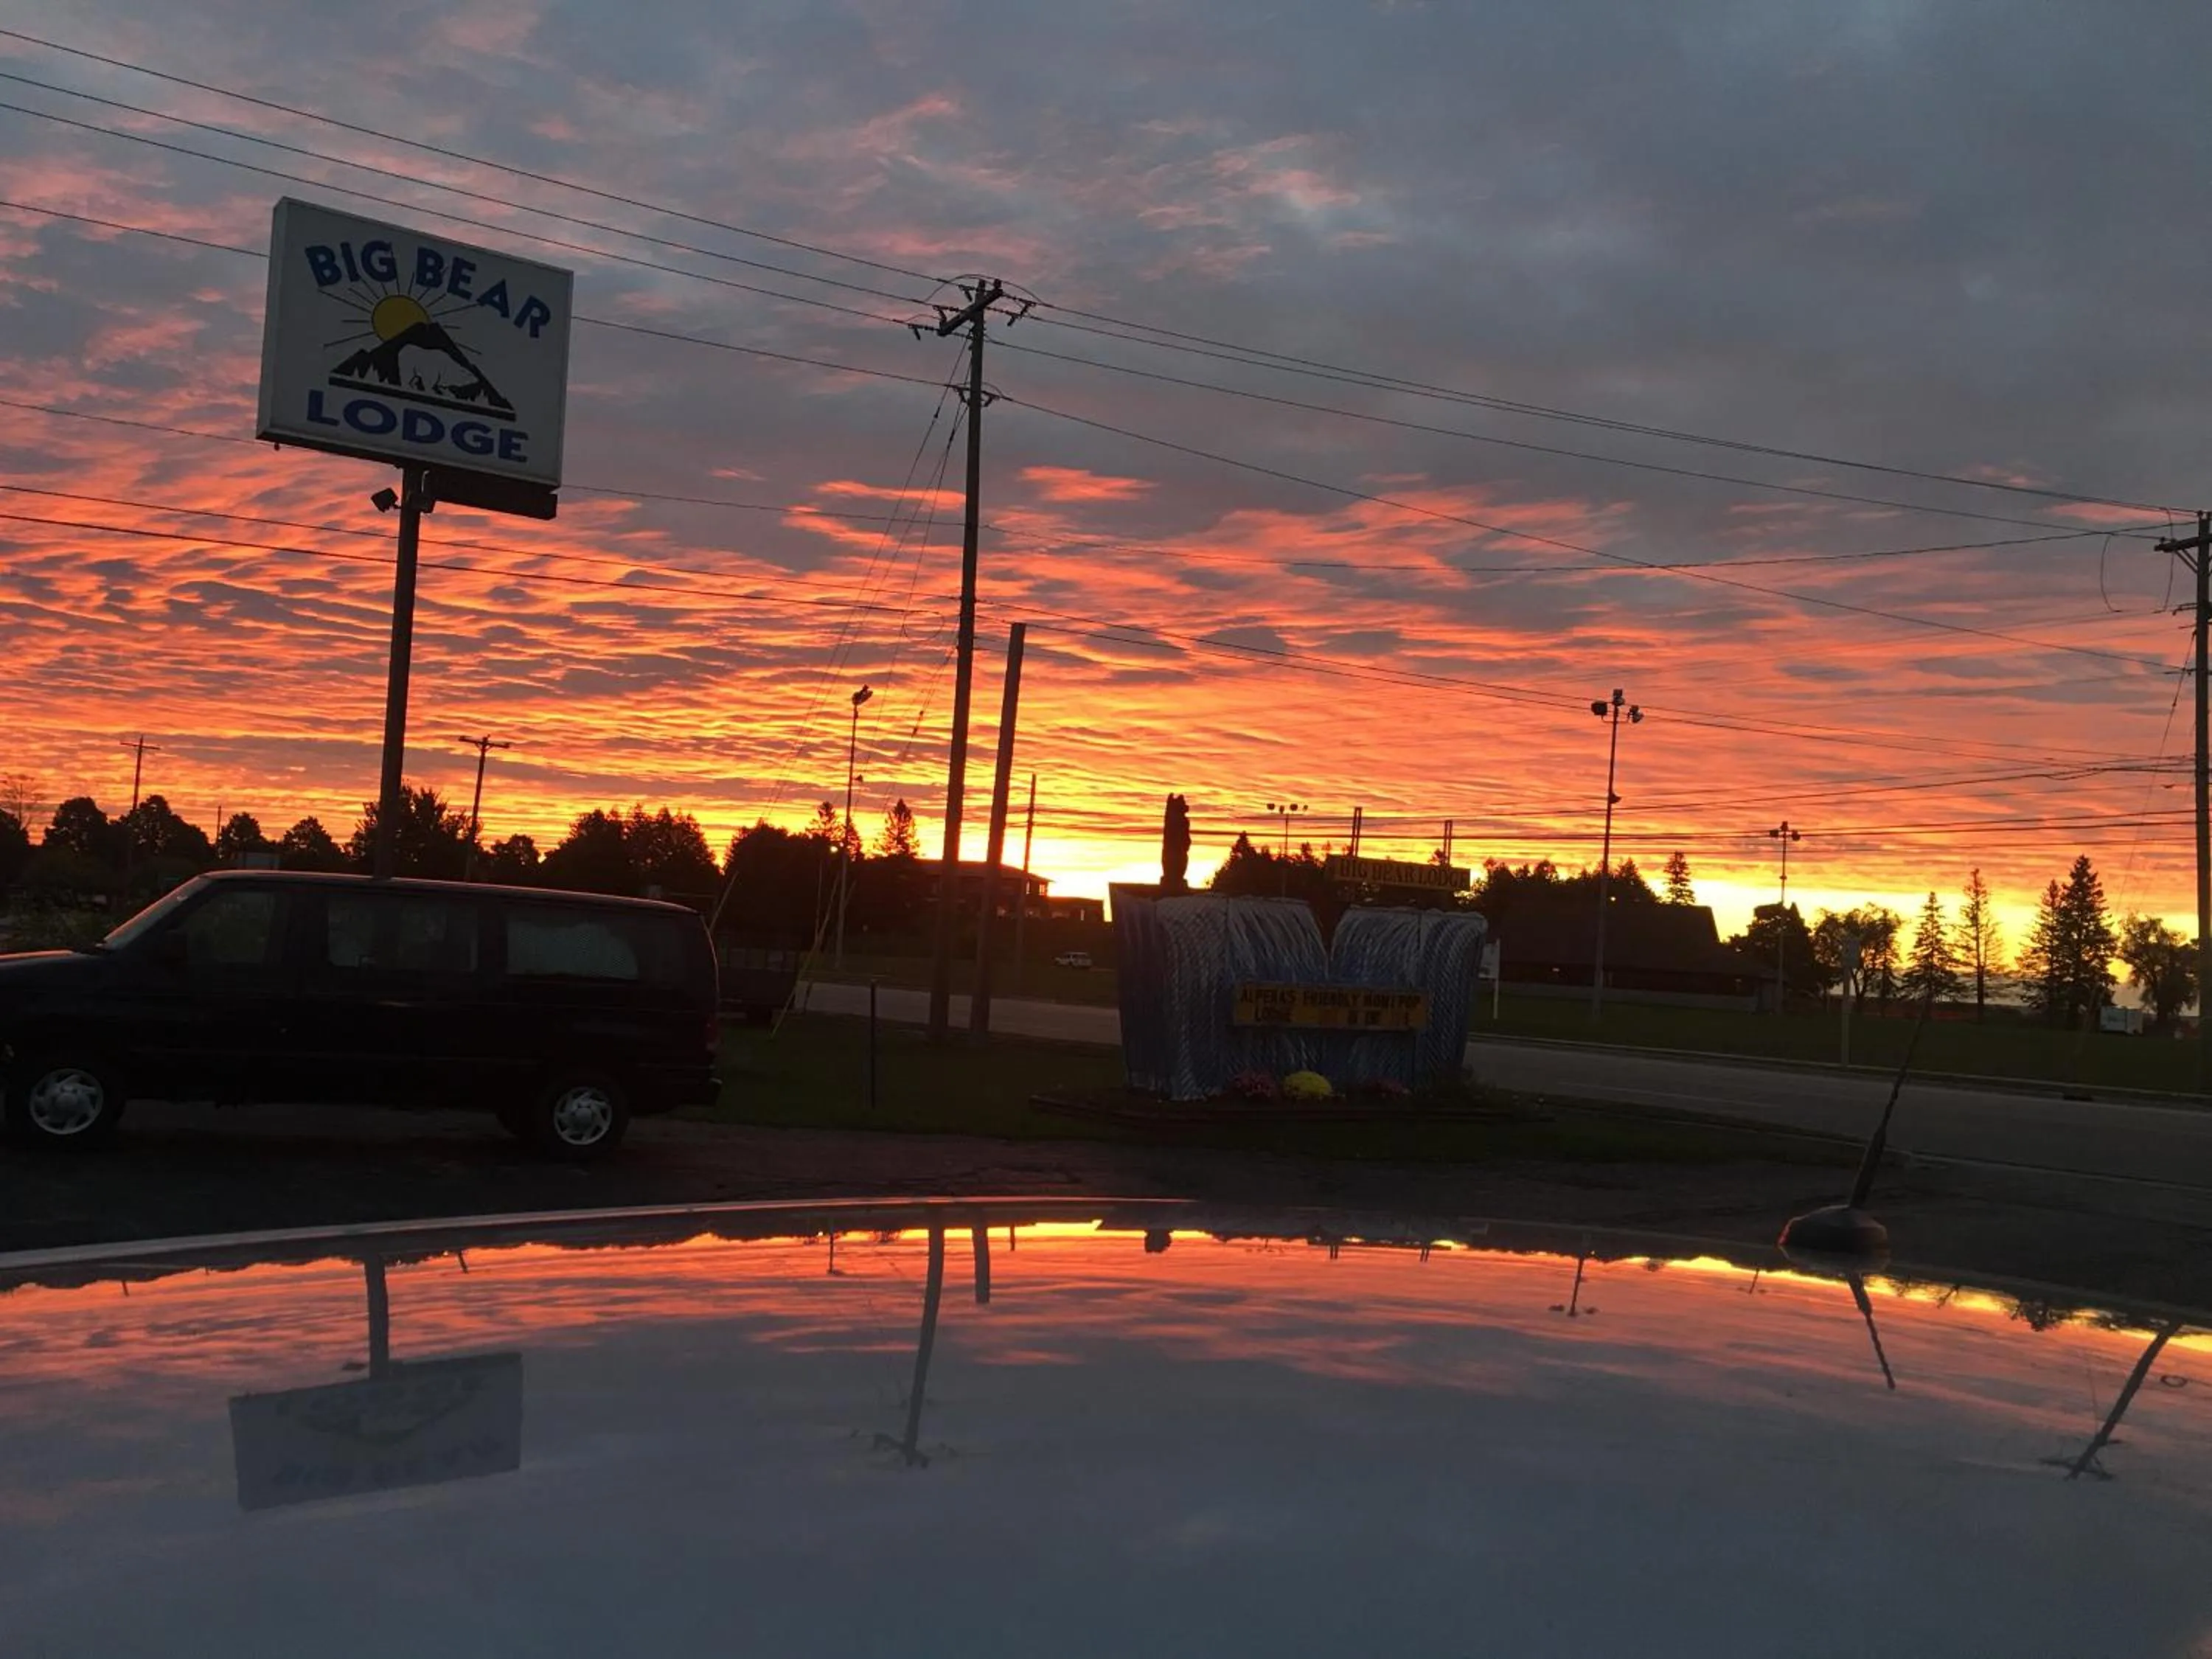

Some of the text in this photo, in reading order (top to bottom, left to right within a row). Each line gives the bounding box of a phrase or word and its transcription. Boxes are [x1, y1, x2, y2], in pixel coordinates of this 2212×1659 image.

[305, 240, 552, 339] BIG BEAR
[307, 389, 529, 463] LODGE
[1340, 859, 1466, 888] BIG BEAR LODGE
